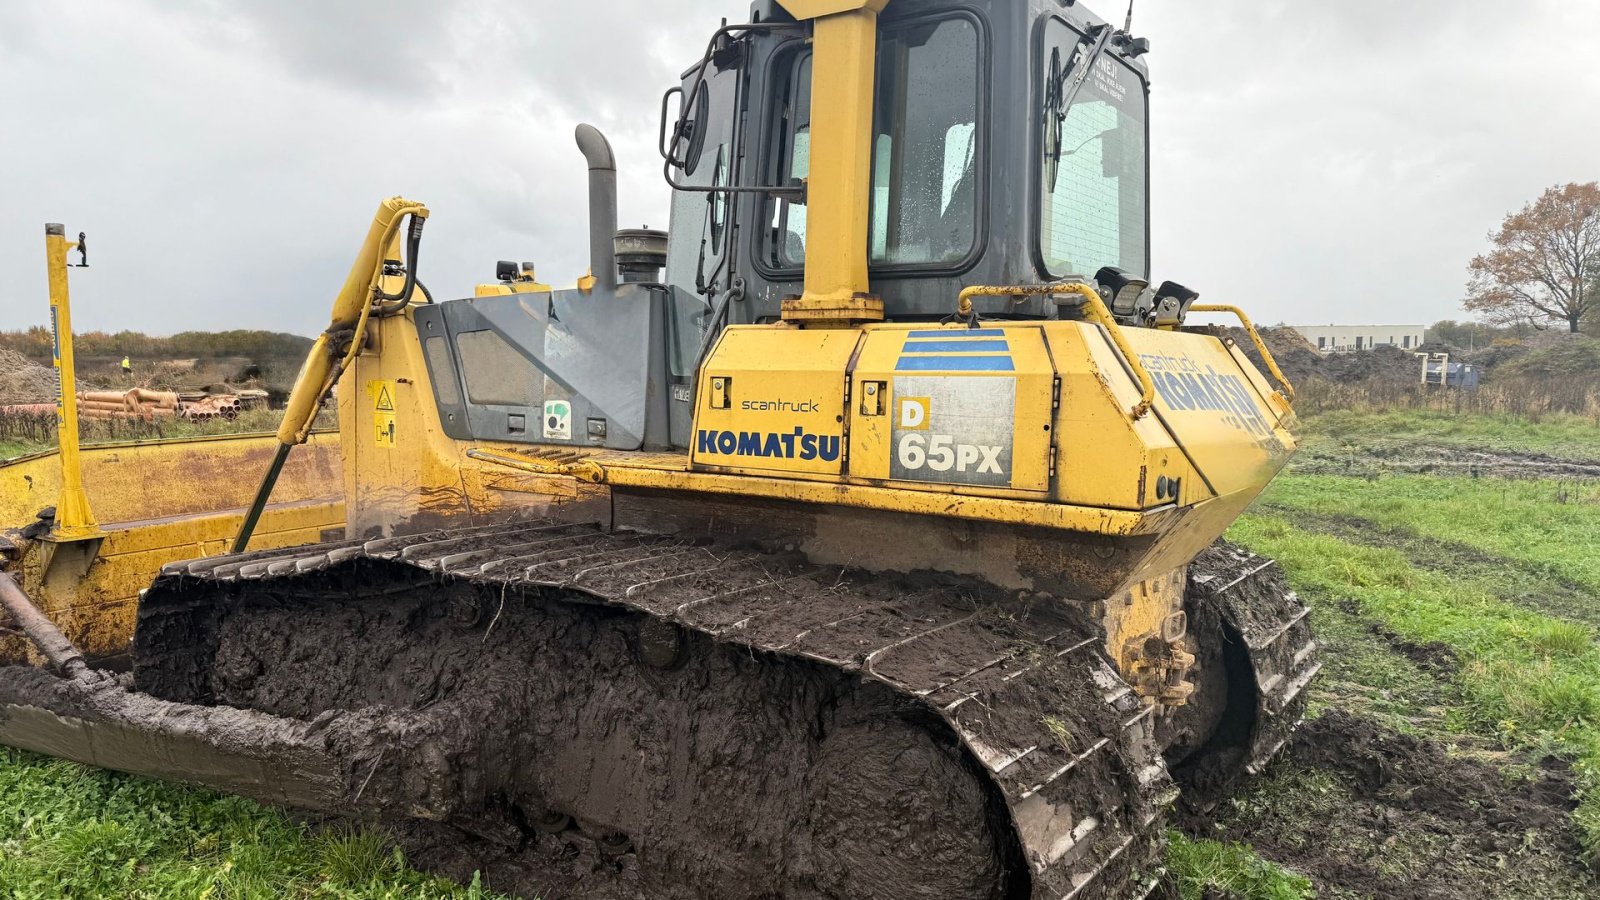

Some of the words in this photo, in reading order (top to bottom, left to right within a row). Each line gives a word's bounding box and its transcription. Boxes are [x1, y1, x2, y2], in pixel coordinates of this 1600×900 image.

[741, 398, 819, 413] scantruck
[901, 402, 925, 427] D
[697, 426, 840, 461] KOMATSU
[898, 434, 1004, 474] 65PX
